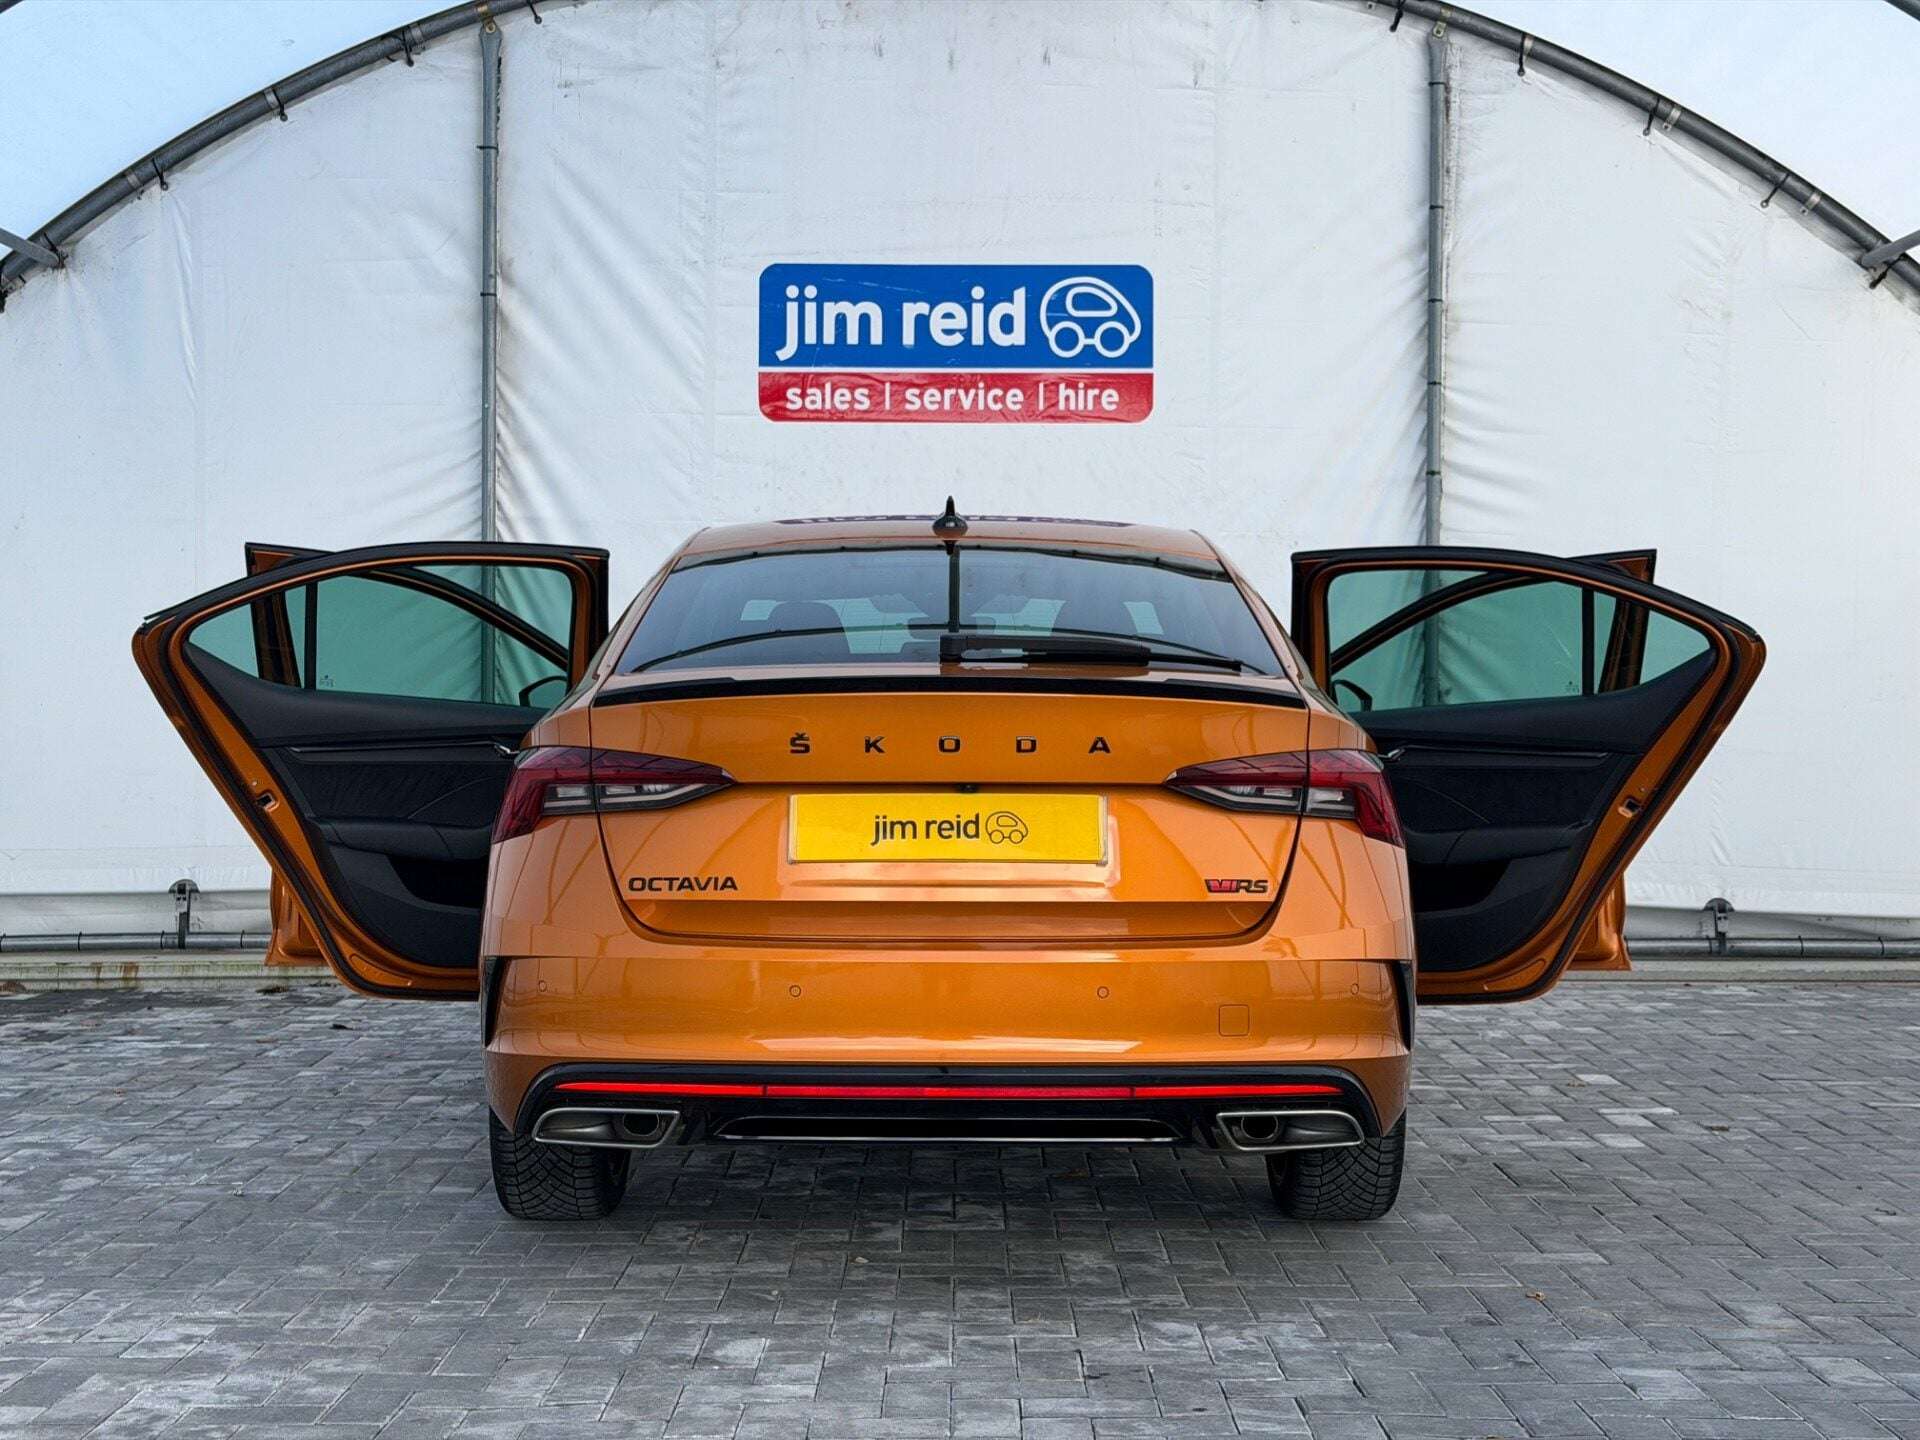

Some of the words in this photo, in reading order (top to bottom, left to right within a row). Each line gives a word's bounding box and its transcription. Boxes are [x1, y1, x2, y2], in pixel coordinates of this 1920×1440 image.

[775, 285, 883, 361] jim
[902, 285, 1026, 346] reid
[785, 382, 870, 411] sales
[904, 382, 1024, 411] service
[1058, 382, 1120, 411] hire
[789, 732, 1111, 754] ŠKODA
[870, 815, 918, 846] jim
[925, 813, 980, 839] reid
[628, 876, 738, 892] OCTAVIA
